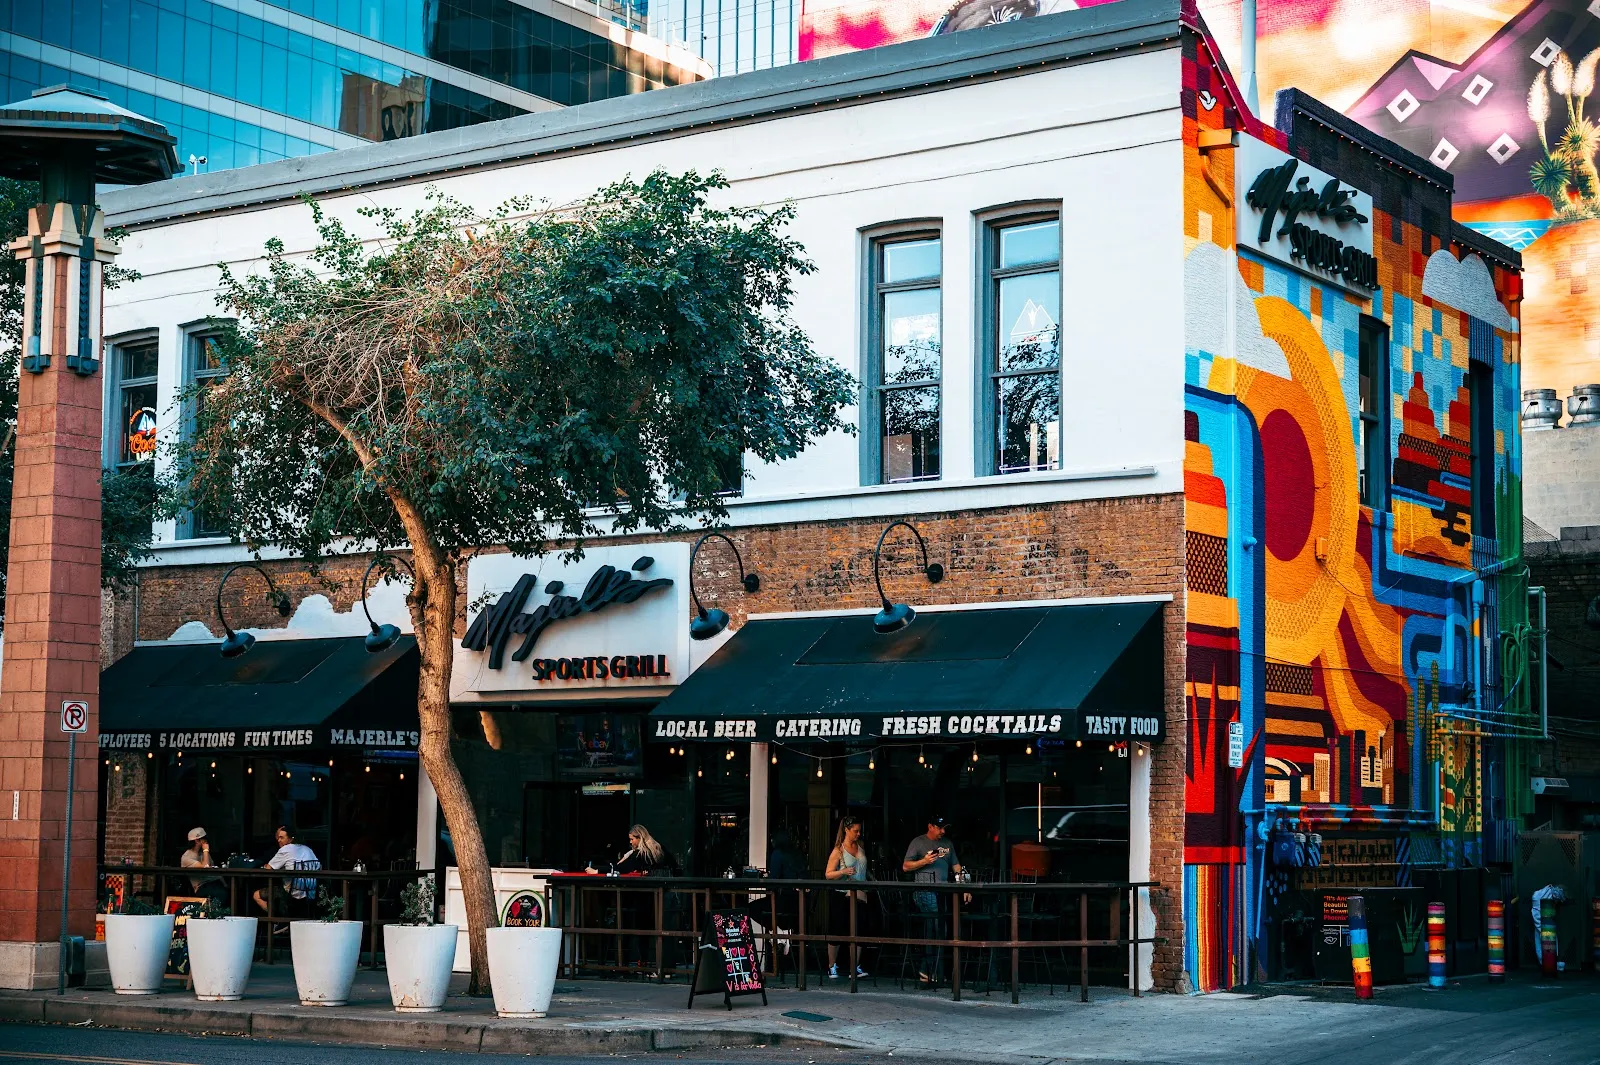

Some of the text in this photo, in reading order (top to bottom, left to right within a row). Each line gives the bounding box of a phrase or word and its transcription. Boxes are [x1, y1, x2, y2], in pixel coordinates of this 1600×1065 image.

[532, 654, 671, 681] SPORTS GRILL
[655, 720, 757, 737] LOCAL BEER
[775, 718, 862, 737] CATERING
[881, 714, 1062, 735] FRESH COCKTAILS
[1085, 715, 1159, 736] TASTY FOOD
[159, 733, 167, 747] 5
[169, 732, 236, 748] LOCATIONS
[244, 731, 270, 746] FUN
[271, 729, 313, 746] TIMES
[330, 728, 419, 746] MAJERLE'S
[507, 917, 541, 927] BOOK YOUR
[726, 980, 733, 992] V
